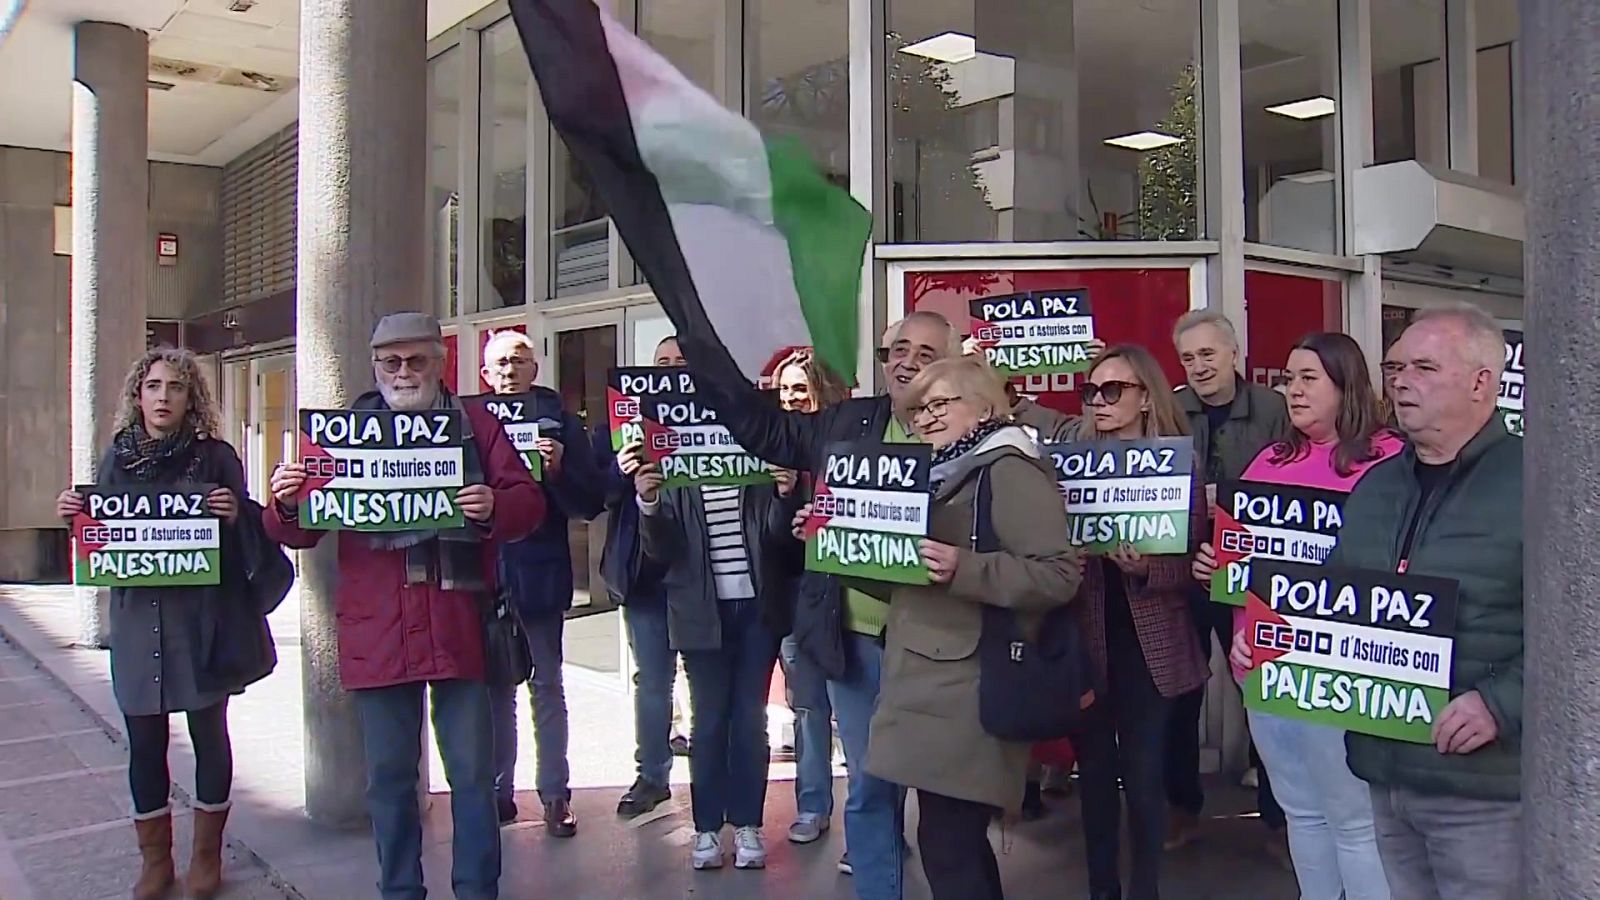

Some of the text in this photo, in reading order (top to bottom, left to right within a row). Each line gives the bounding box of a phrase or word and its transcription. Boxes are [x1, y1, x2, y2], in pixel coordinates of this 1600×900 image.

[983, 297, 1078, 321] POLA PAZ
[1072, 324, 1087, 335] con
[985, 344, 1087, 370] PALESTINA
[620, 374, 672, 394] POLA
[310, 412, 450, 446] POLA PAZ
[517, 431, 533, 443] con
[652, 432, 706, 449] CCOO
[304, 455, 457, 479] CCOO d'Asturies con
[825, 454, 918, 487] POLA PAZ
[1126, 449, 1176, 475] PAZ
[89, 493, 203, 518] POLA PAZ
[1102, 485, 1158, 503] d'Asturies
[1161, 486, 1182, 501] con
[309, 489, 454, 527] PALESTINA
[904, 506, 921, 522] con
[1233, 491, 1303, 525] POLA
[83, 526, 213, 543] CCOO d'Asturies con
[1067, 513, 1177, 546] LESTINA
[817, 527, 920, 568] PALESTINA
[1221, 530, 1285, 557] CCOO
[89, 551, 211, 579] PALESTINA
[1270, 574, 1358, 616] POLA
[1370, 586, 1433, 628] PAZ
[1254, 621, 1440, 673] CCOO d'Asturies con
[1261, 661, 1432, 724] PALESTINA
